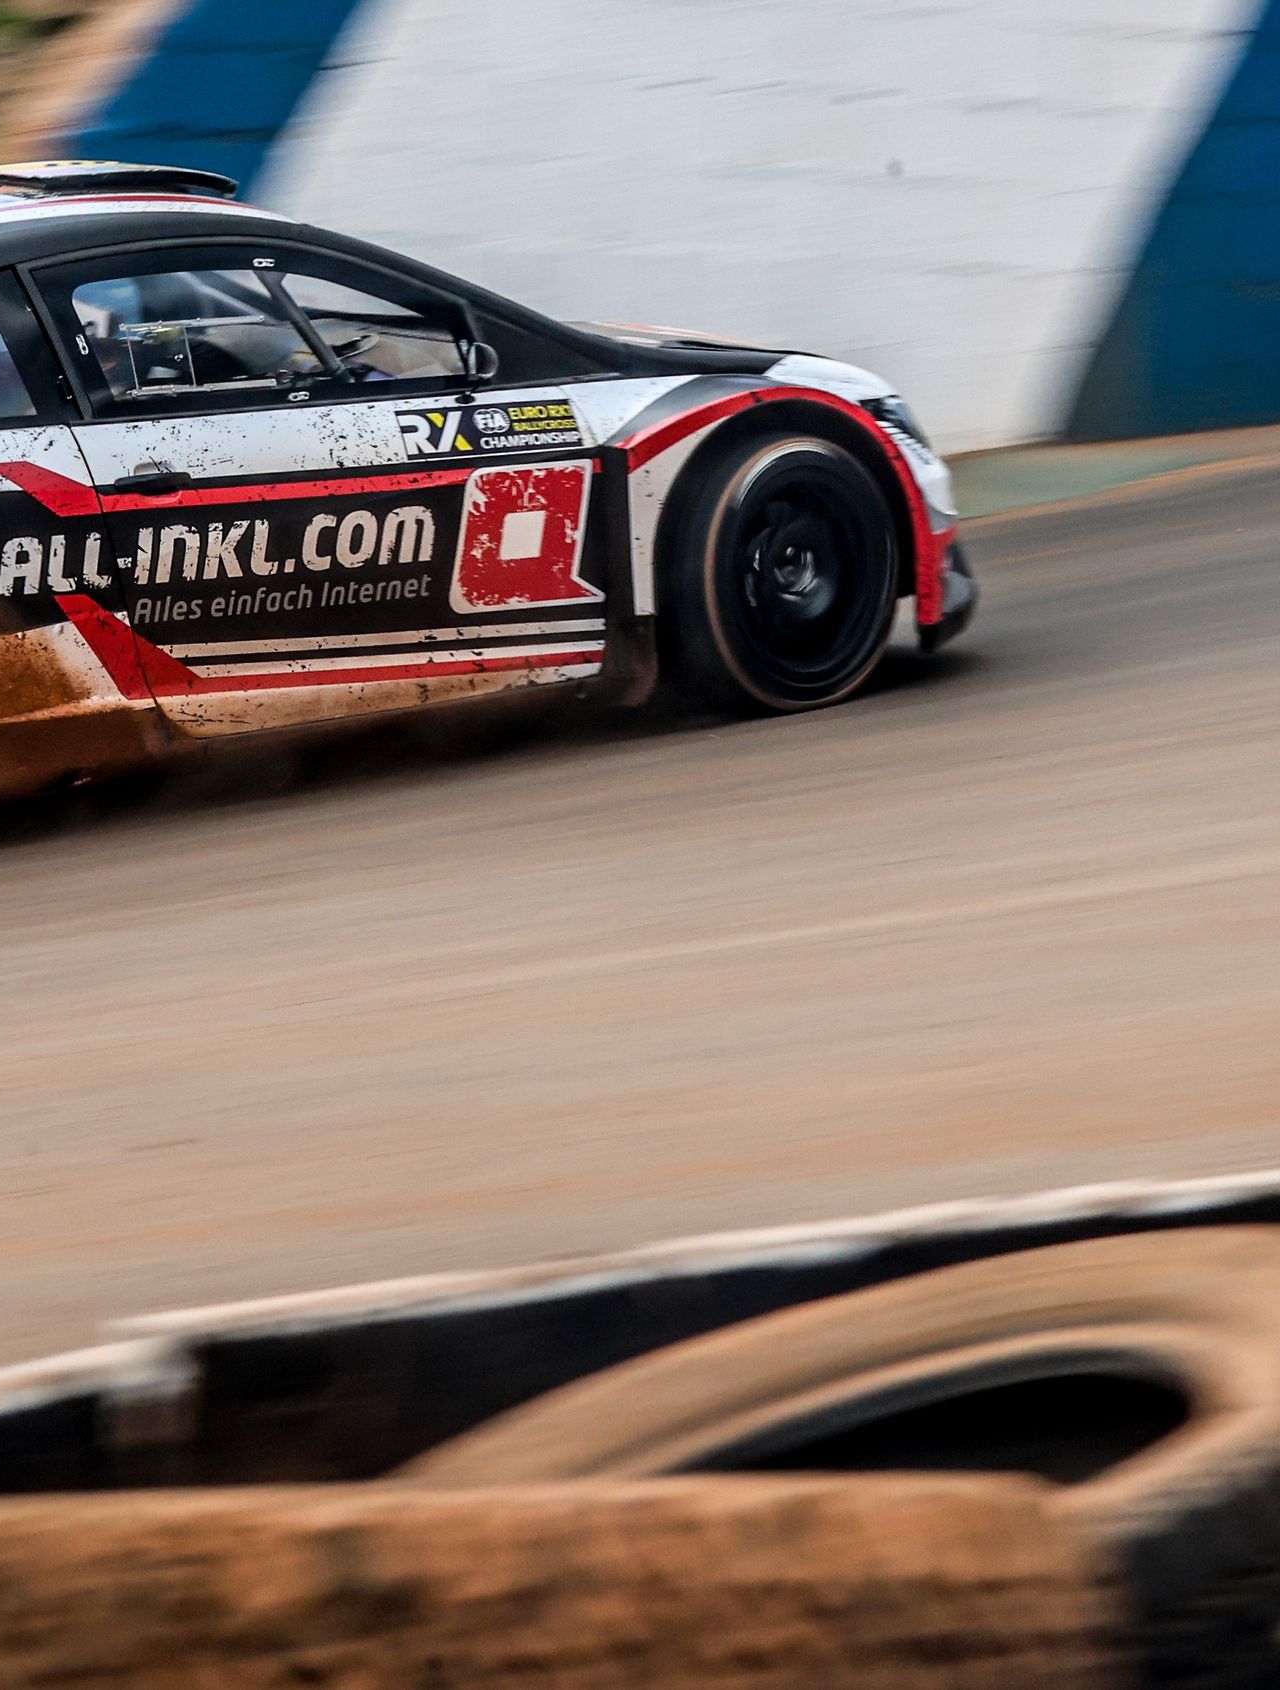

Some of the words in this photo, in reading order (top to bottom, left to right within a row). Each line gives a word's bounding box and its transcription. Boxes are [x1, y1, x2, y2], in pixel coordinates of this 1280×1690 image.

[508, 406, 547, 420] EURO
[397, 411, 473, 455] RX
[513, 420, 576, 432] RALLYCROSS
[480, 431, 581, 449] CHAMPIONSHIP
[210, 584, 314, 618] einfach
[320, 573, 432, 608] Internet
